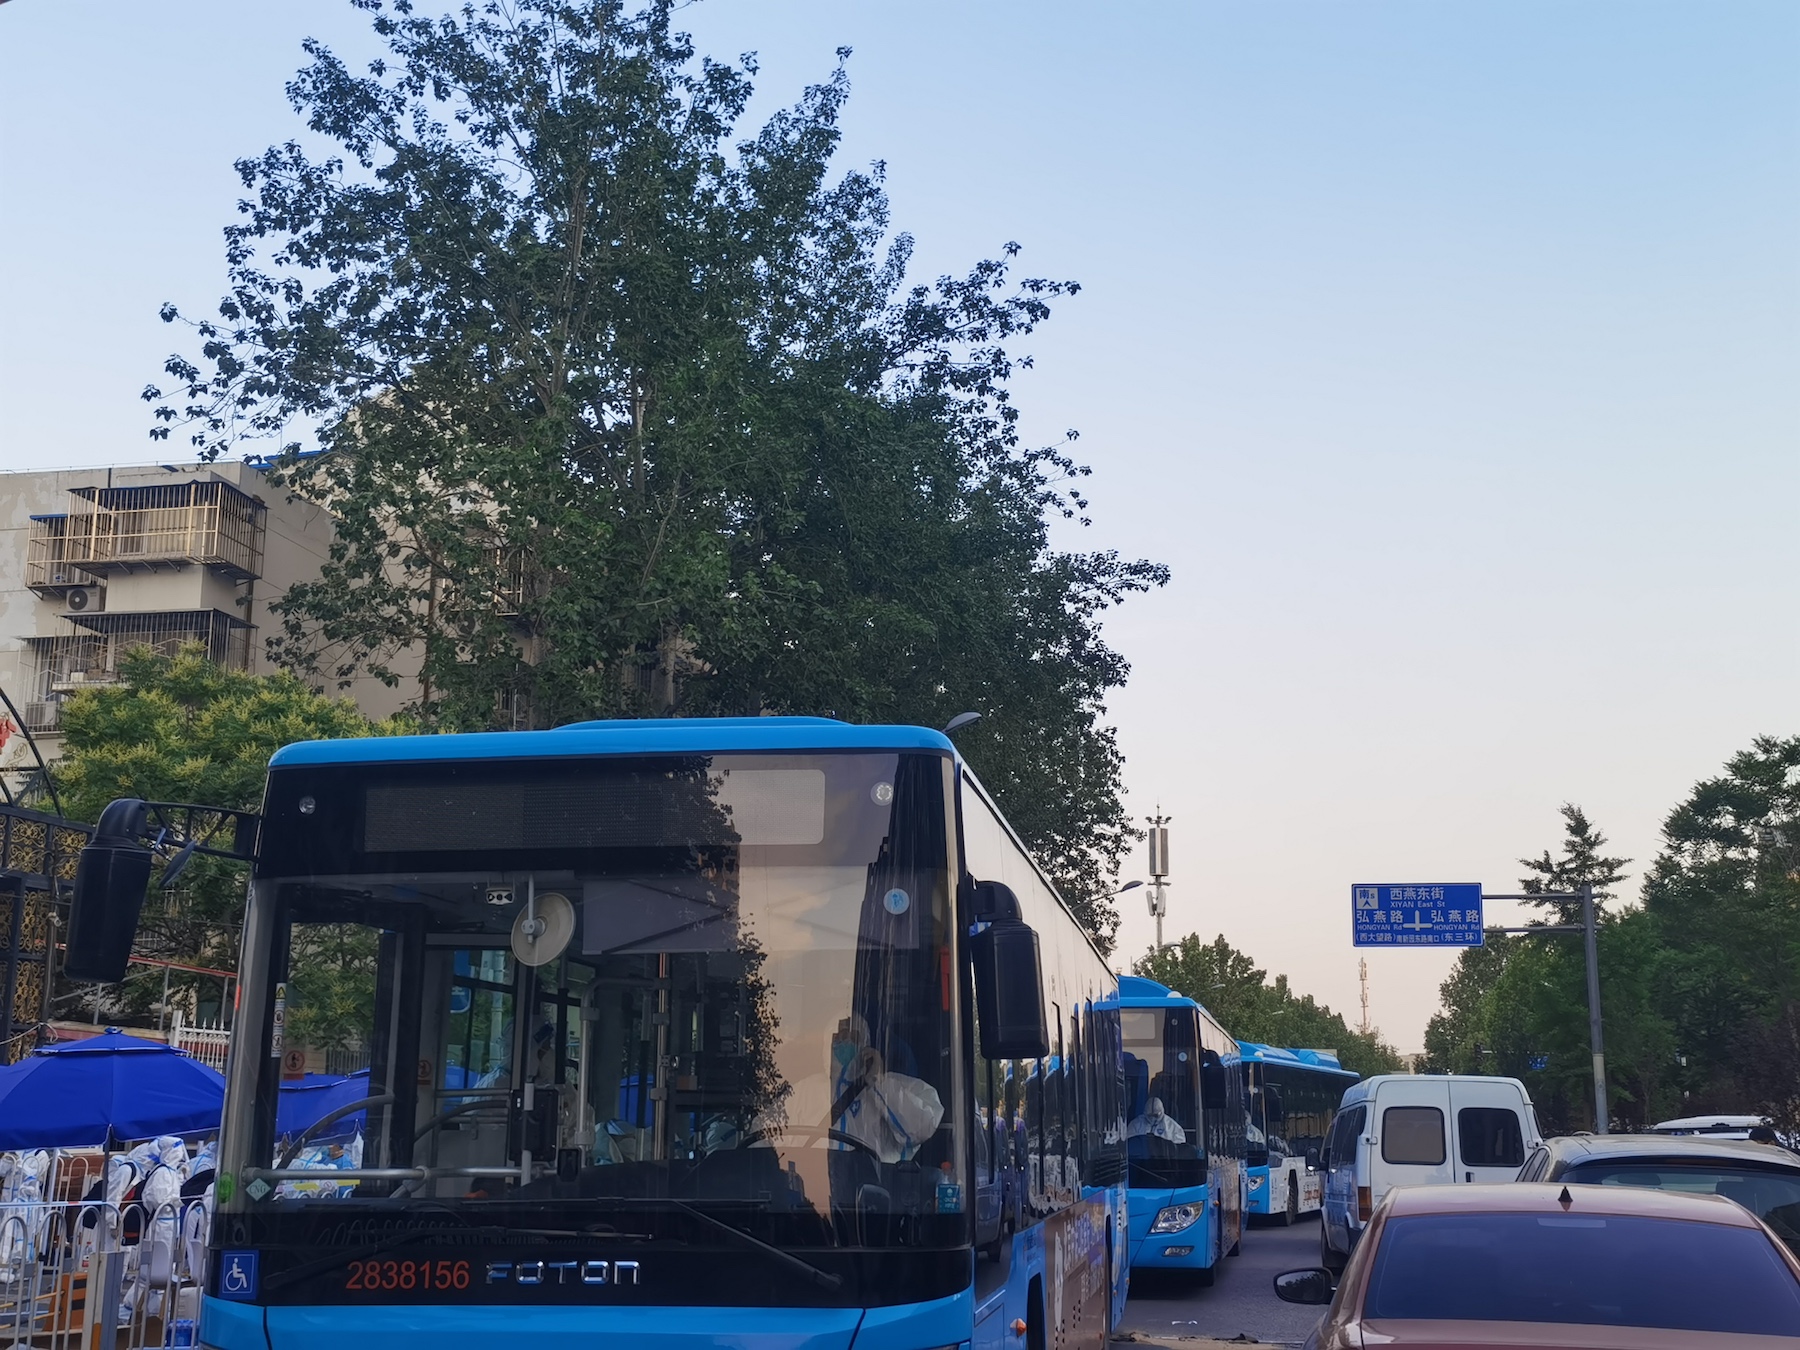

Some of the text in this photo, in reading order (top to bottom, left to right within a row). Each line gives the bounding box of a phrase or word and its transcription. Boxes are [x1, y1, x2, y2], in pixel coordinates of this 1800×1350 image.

[1359, 889, 1370, 899] 南
[1389, 887, 1445, 900] 西燕东街
[1356, 910, 1403, 923] 弘燕路
[1431, 910, 1479, 923] 弘燕路
[249, 1184, 266, 1194] CNG
[345, 1260, 471, 1290] 2838156
[485, 1260, 641, 1285] FOTON
